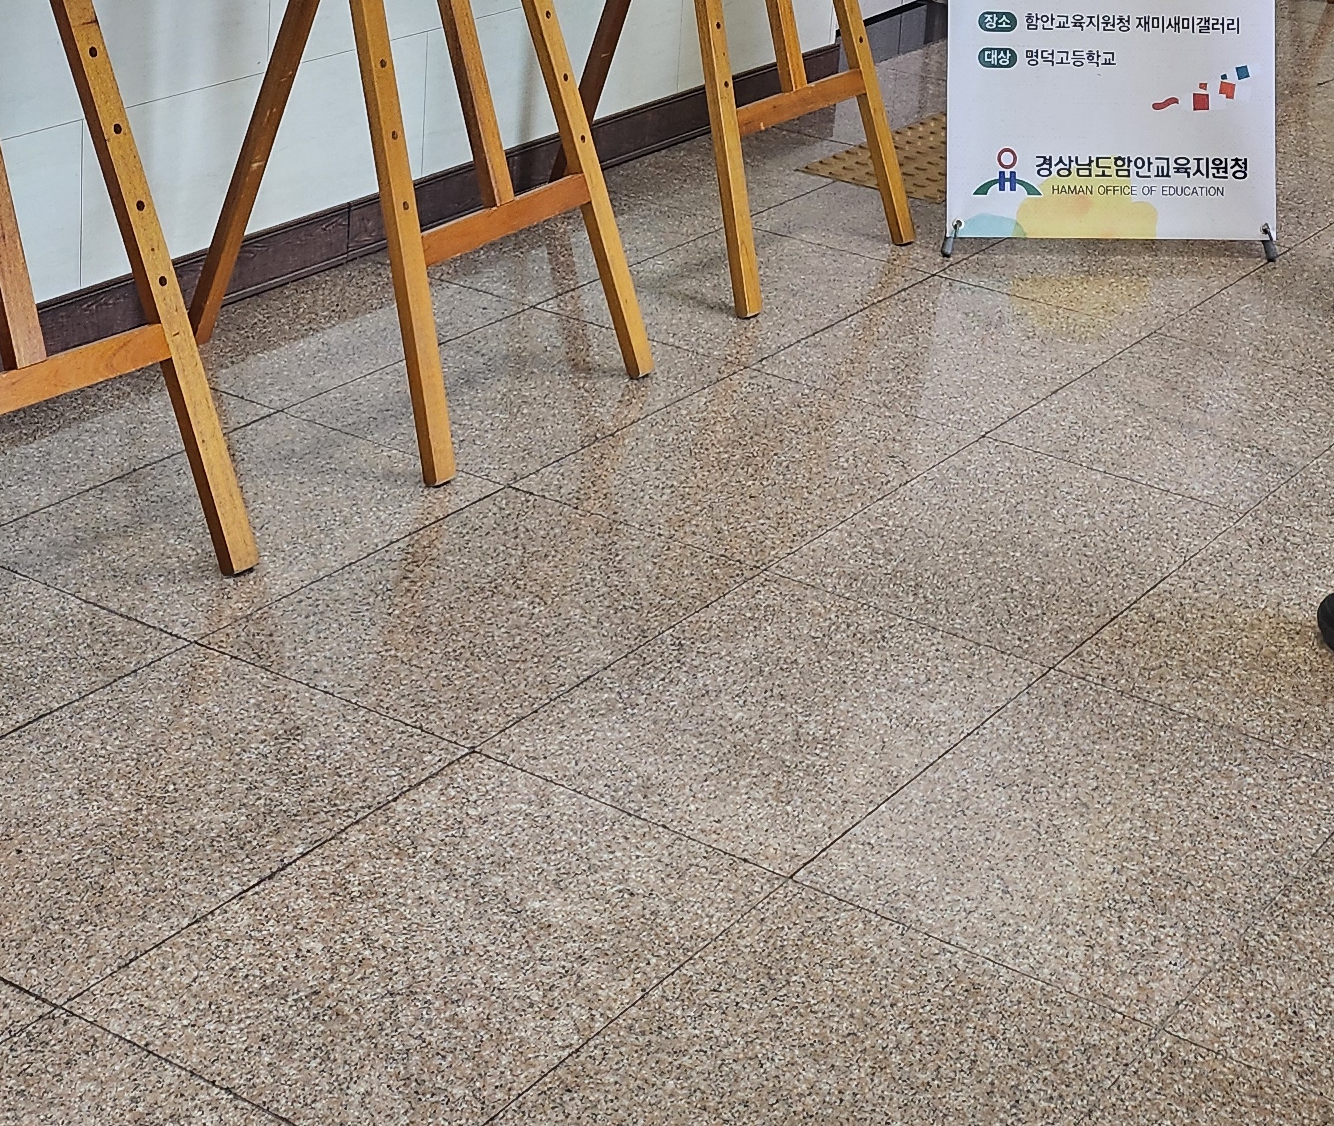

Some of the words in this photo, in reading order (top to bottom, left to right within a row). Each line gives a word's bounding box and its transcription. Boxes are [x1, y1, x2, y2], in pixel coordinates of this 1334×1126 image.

[983, 14, 1011, 30] 장소
[1024, 13, 1131, 32] 함안교육지원청
[1135, 15, 1241, 34] 재미새미갤러리
[984, 48, 1011, 66] 대상
[1025, 50, 1116, 67] 명덕고등학교
[1035, 155, 1249, 181] 경상남도함안교육지원청
[1052, 184, 1093, 196] HAMAN
[1097, 184, 1138, 196] OFFICE
[1141, 185, 1157, 196] OF
[1161, 186, 1224, 197] EDUCATION
